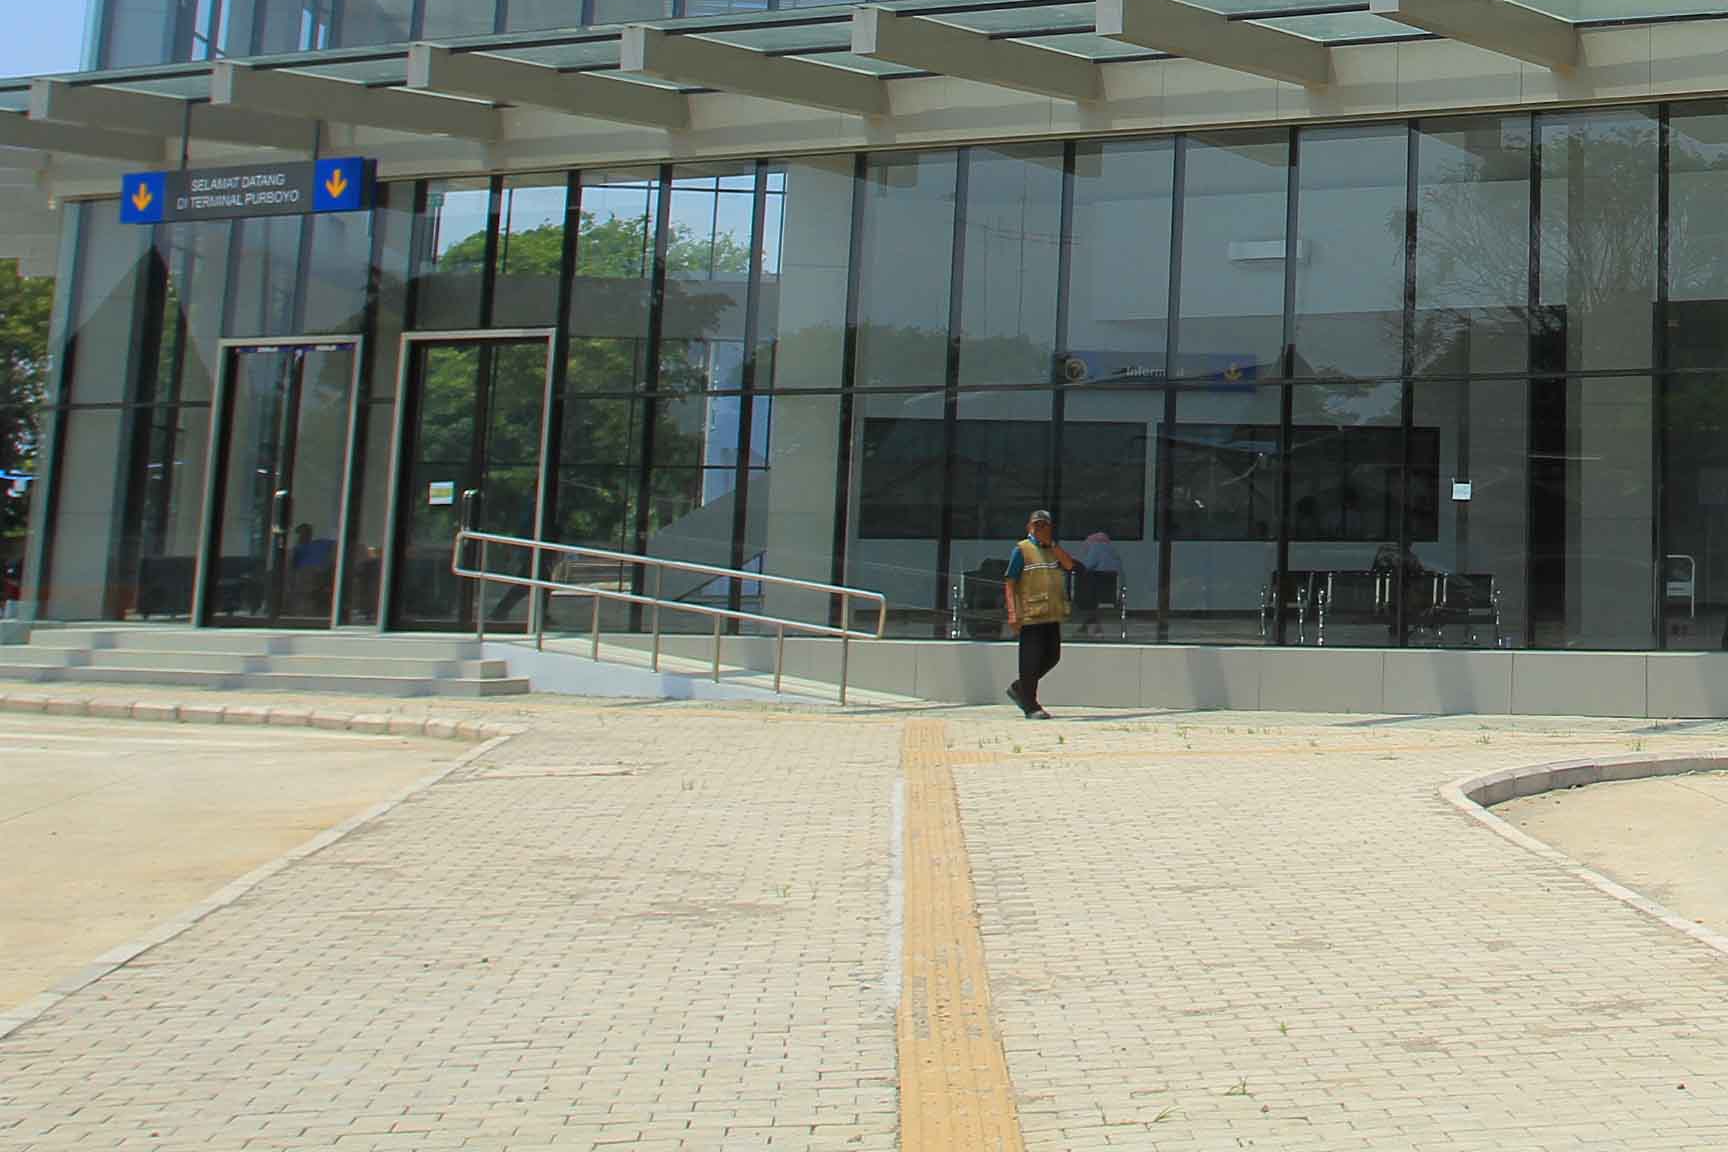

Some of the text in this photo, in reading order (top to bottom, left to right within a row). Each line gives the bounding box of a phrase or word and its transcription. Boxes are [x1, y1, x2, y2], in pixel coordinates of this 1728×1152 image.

[191, 174, 285, 191] SELAMAT DATANG
[176, 190, 299, 210] DI TERMINAL PURBOYO
